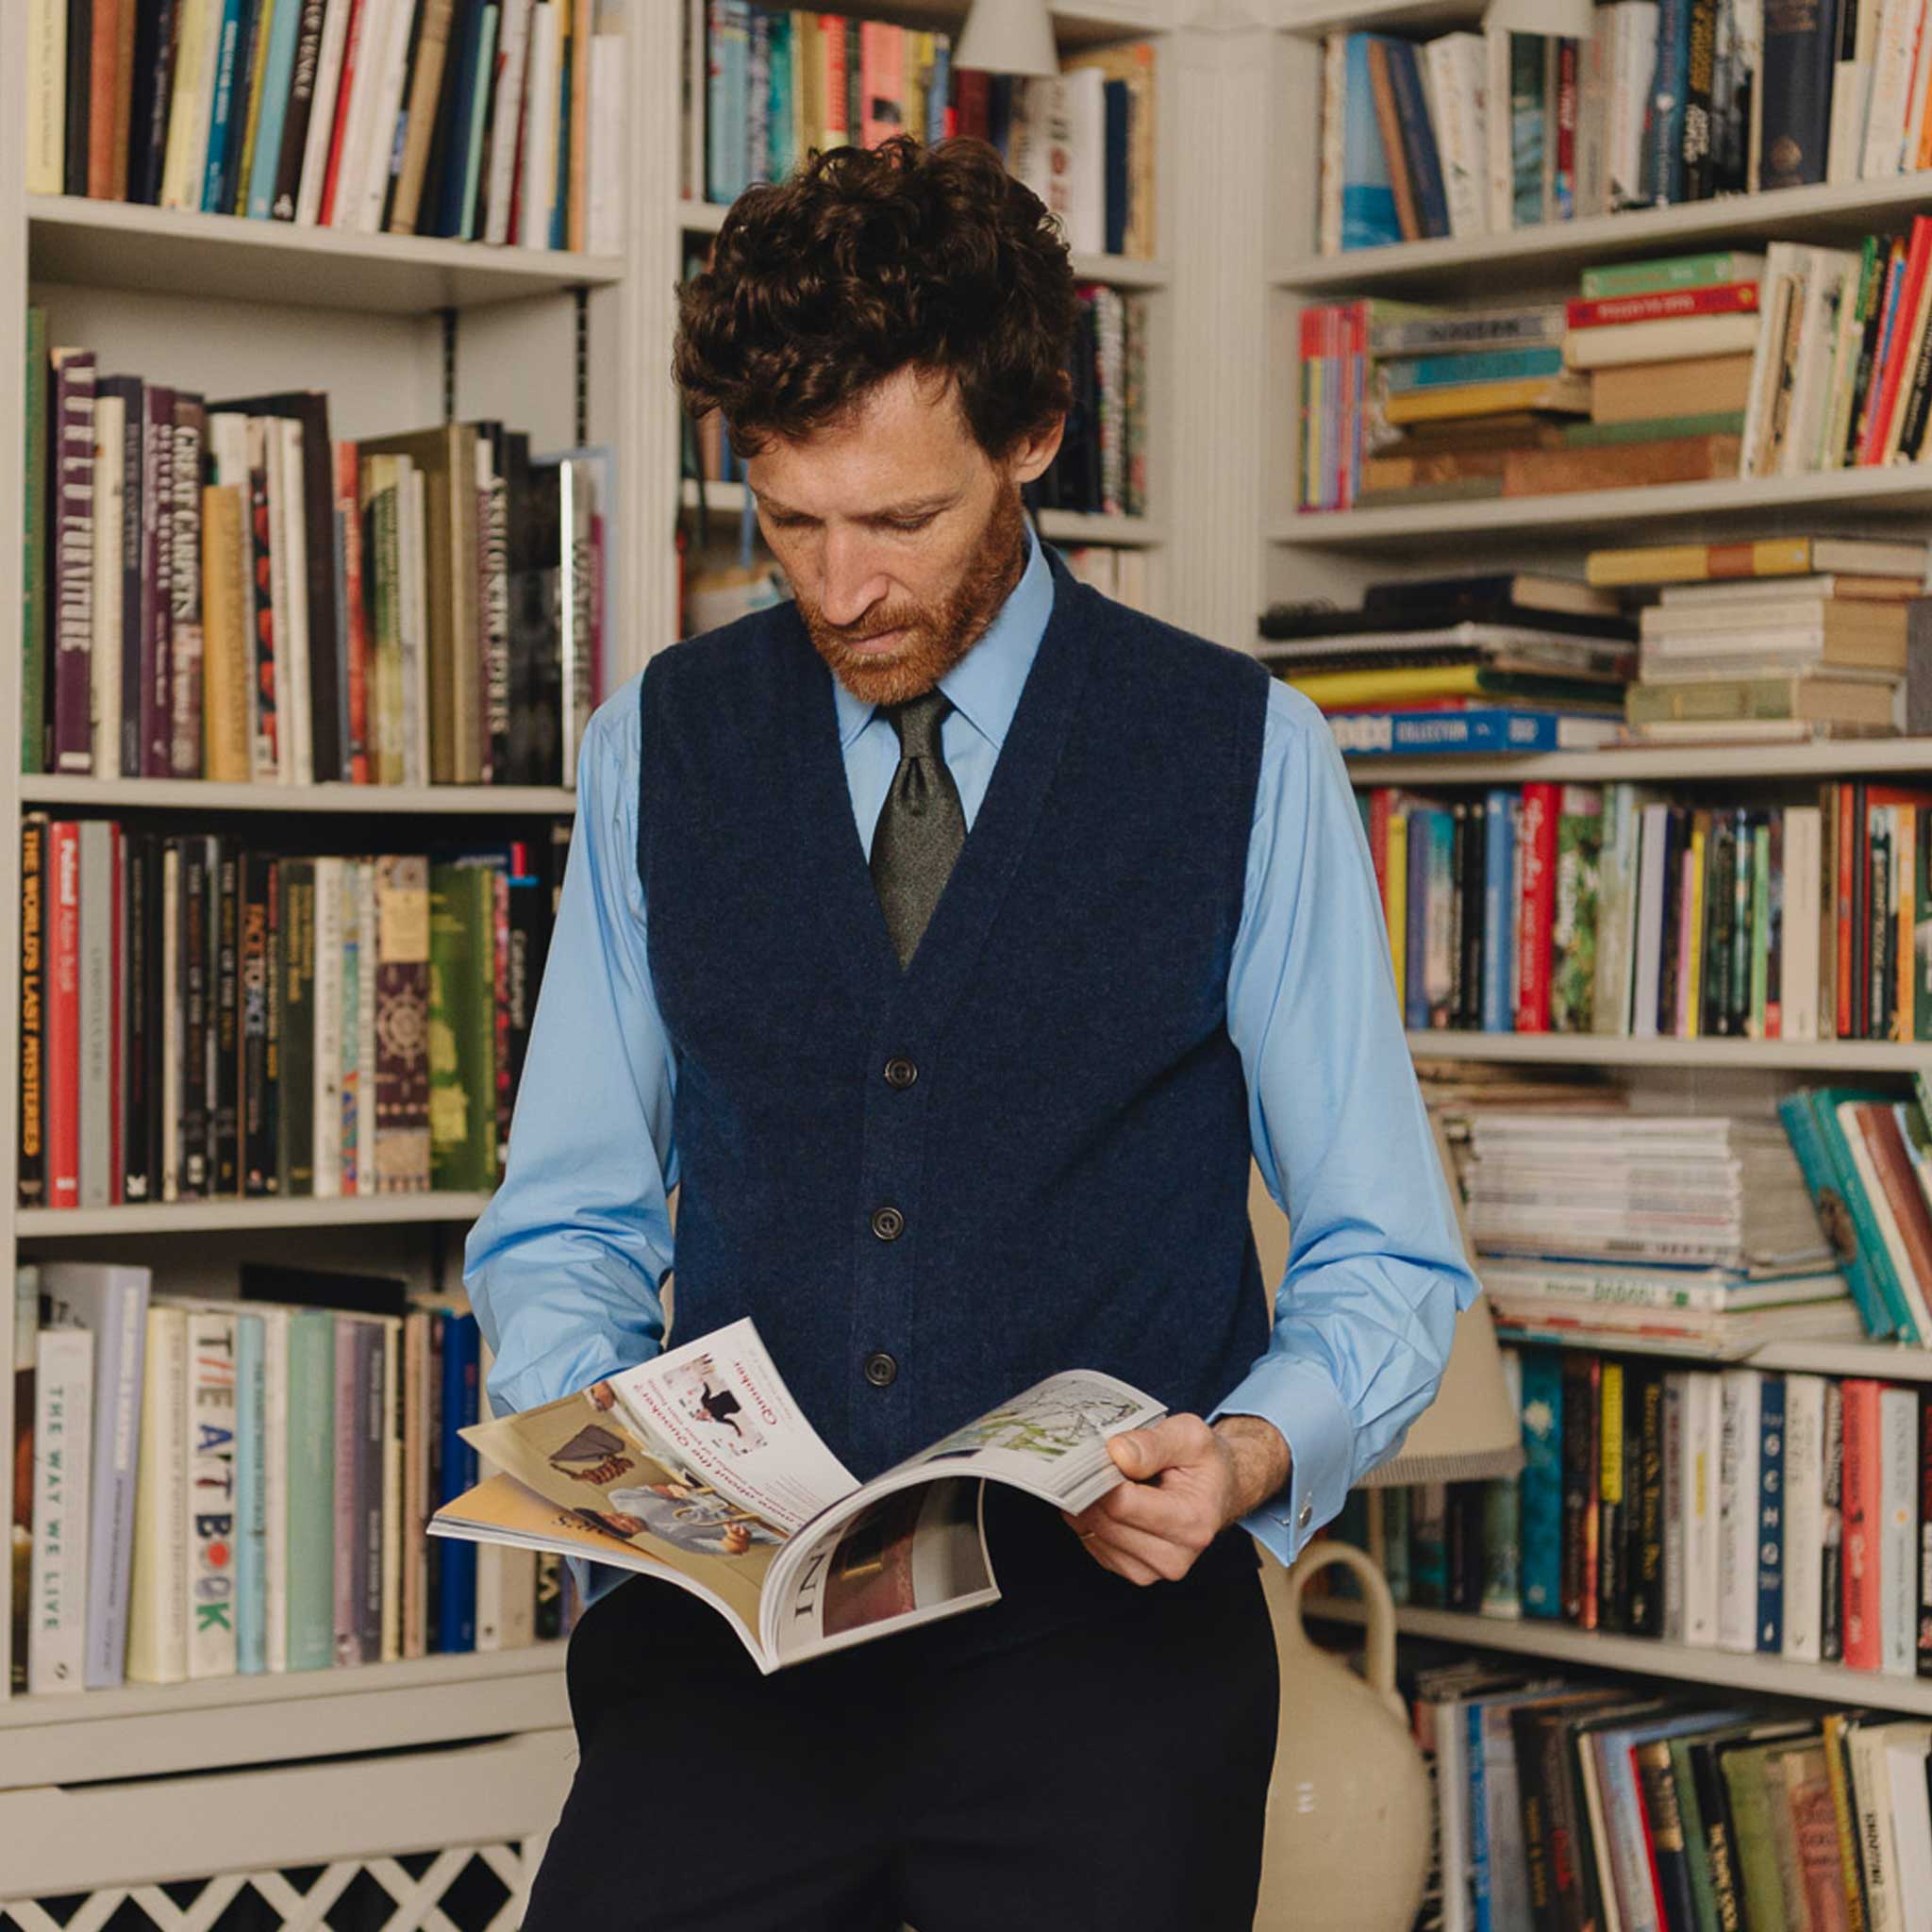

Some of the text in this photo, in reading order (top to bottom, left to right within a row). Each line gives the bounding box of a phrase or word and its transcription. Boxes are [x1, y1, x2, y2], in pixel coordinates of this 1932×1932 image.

[172, 426, 199, 620] GREAT CARPETS
[24, 831, 42, 1157] THE WORLD'S LAST MYSTERIES
[44, 1385, 63, 1630] THE WAY WE LIVE
[195, 1327, 236, 1632] THE ART BOOK
